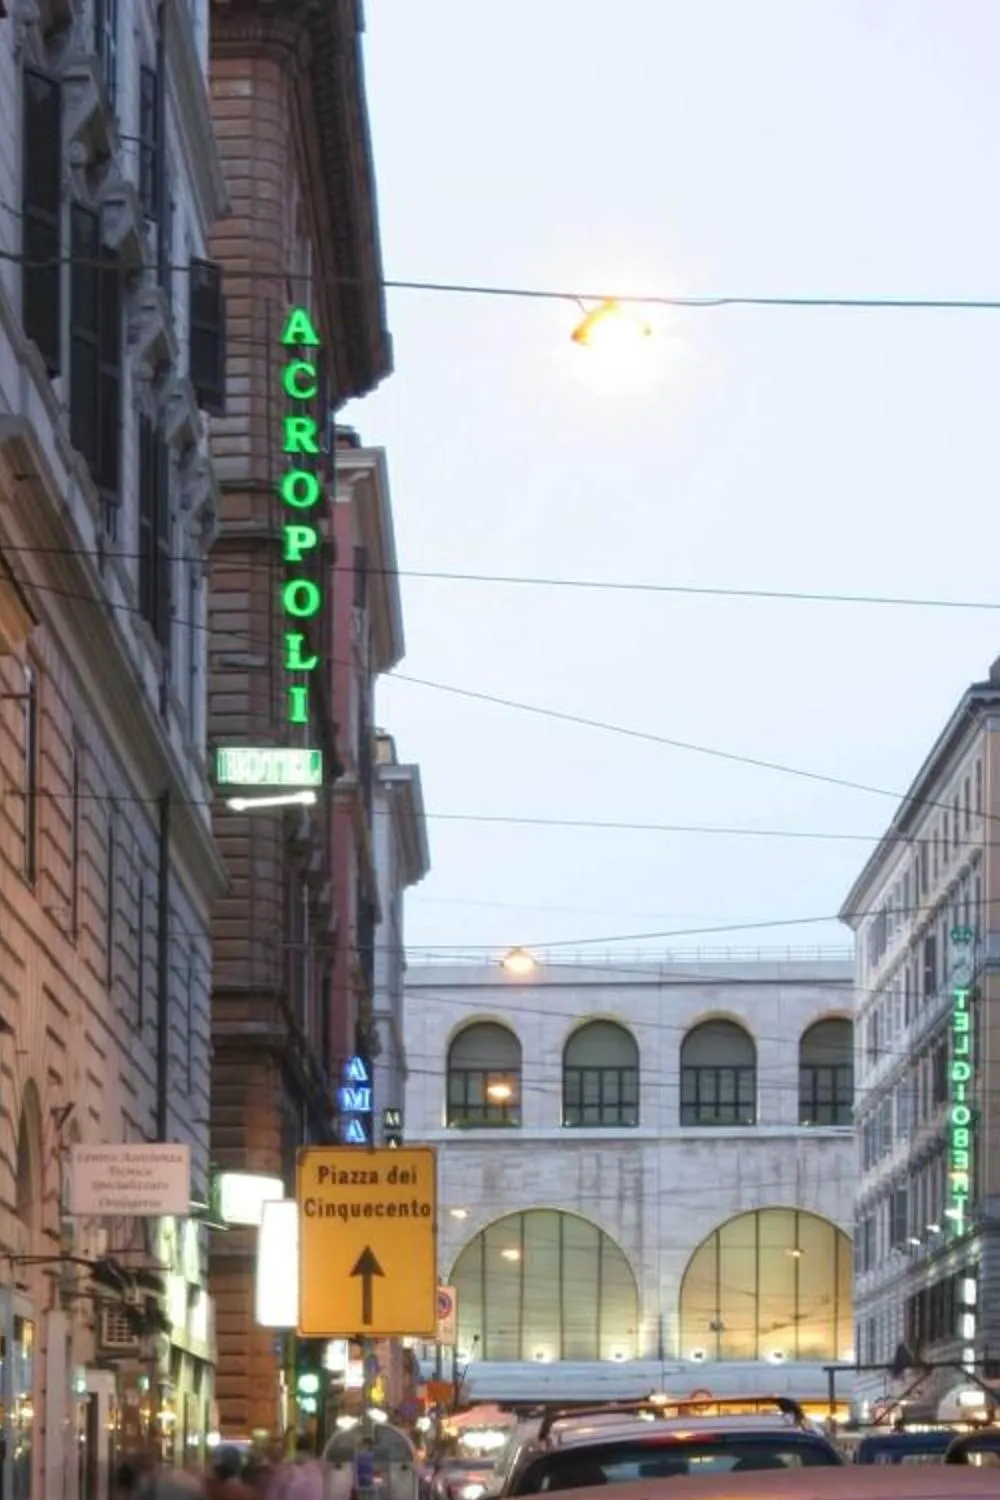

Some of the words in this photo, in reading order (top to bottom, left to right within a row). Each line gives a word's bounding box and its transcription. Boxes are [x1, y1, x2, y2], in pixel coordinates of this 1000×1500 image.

[280, 306, 321, 724] ACROPOLI
[317, 1165, 379, 1185] Piazza
[386, 1164, 418, 1185] dei
[303, 1198, 431, 1222] Cinquecento
